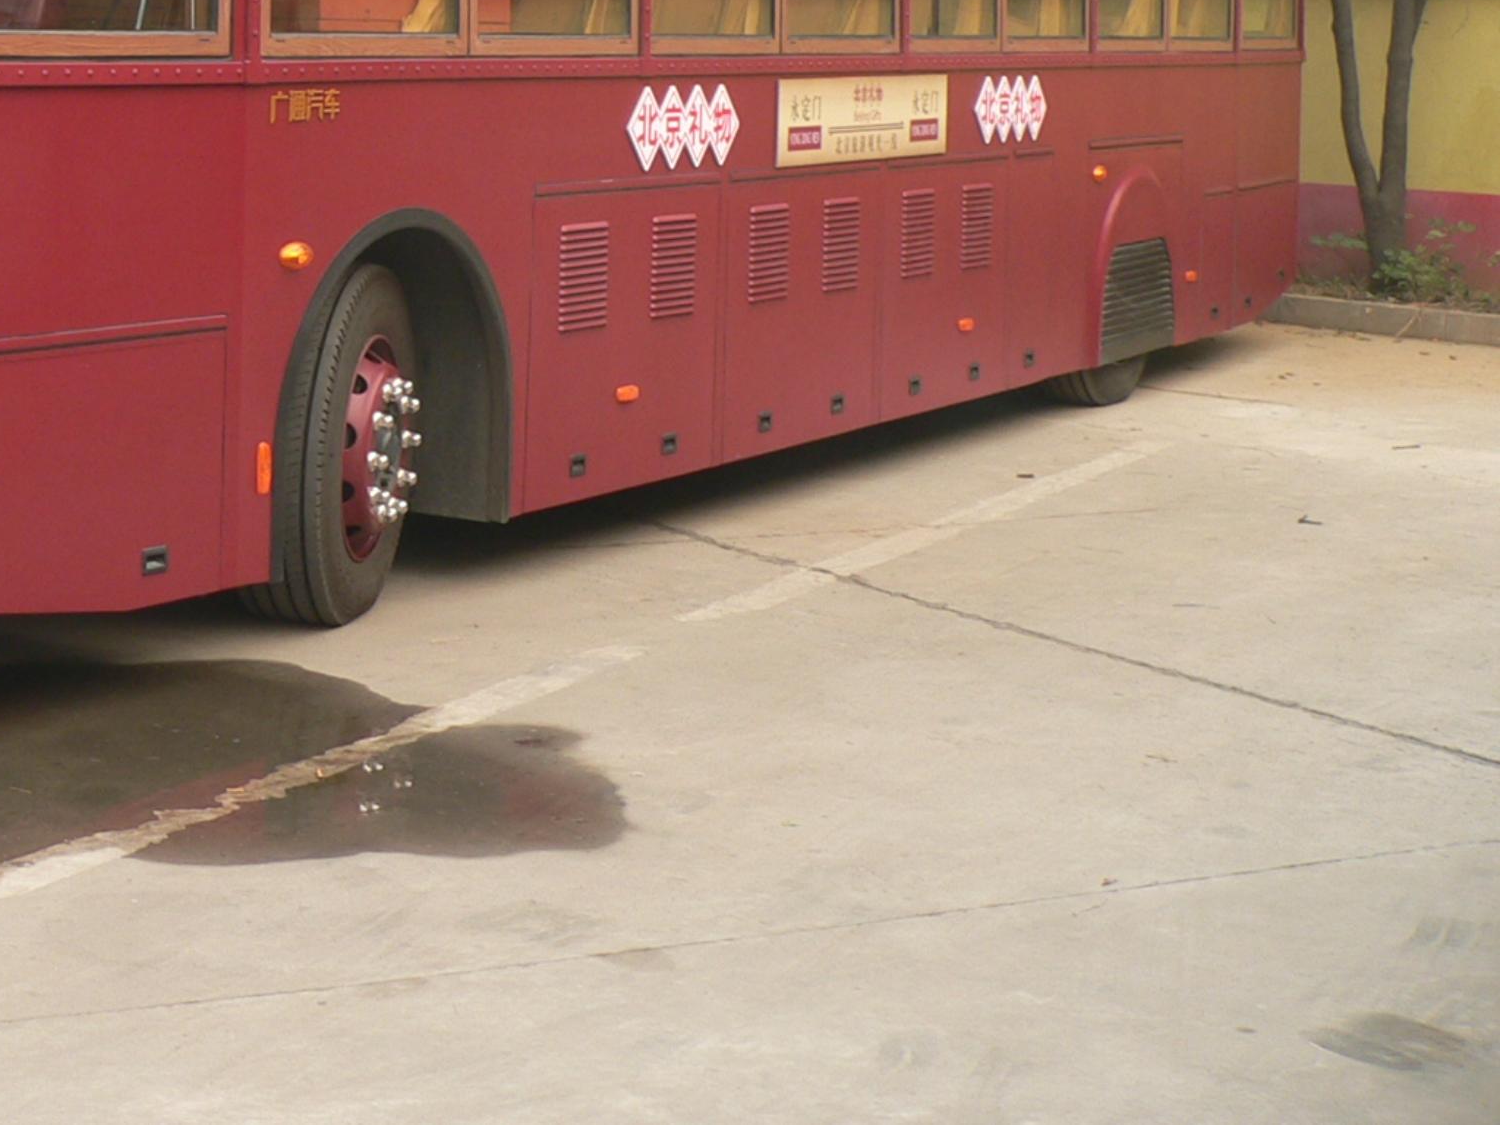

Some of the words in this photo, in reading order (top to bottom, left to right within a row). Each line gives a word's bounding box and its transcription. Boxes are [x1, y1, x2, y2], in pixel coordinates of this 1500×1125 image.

[270, 88, 341, 124] 广通汽车
[981, 90, 1042, 125] 北京礼物
[637, 103, 732, 148] 北京礼物
